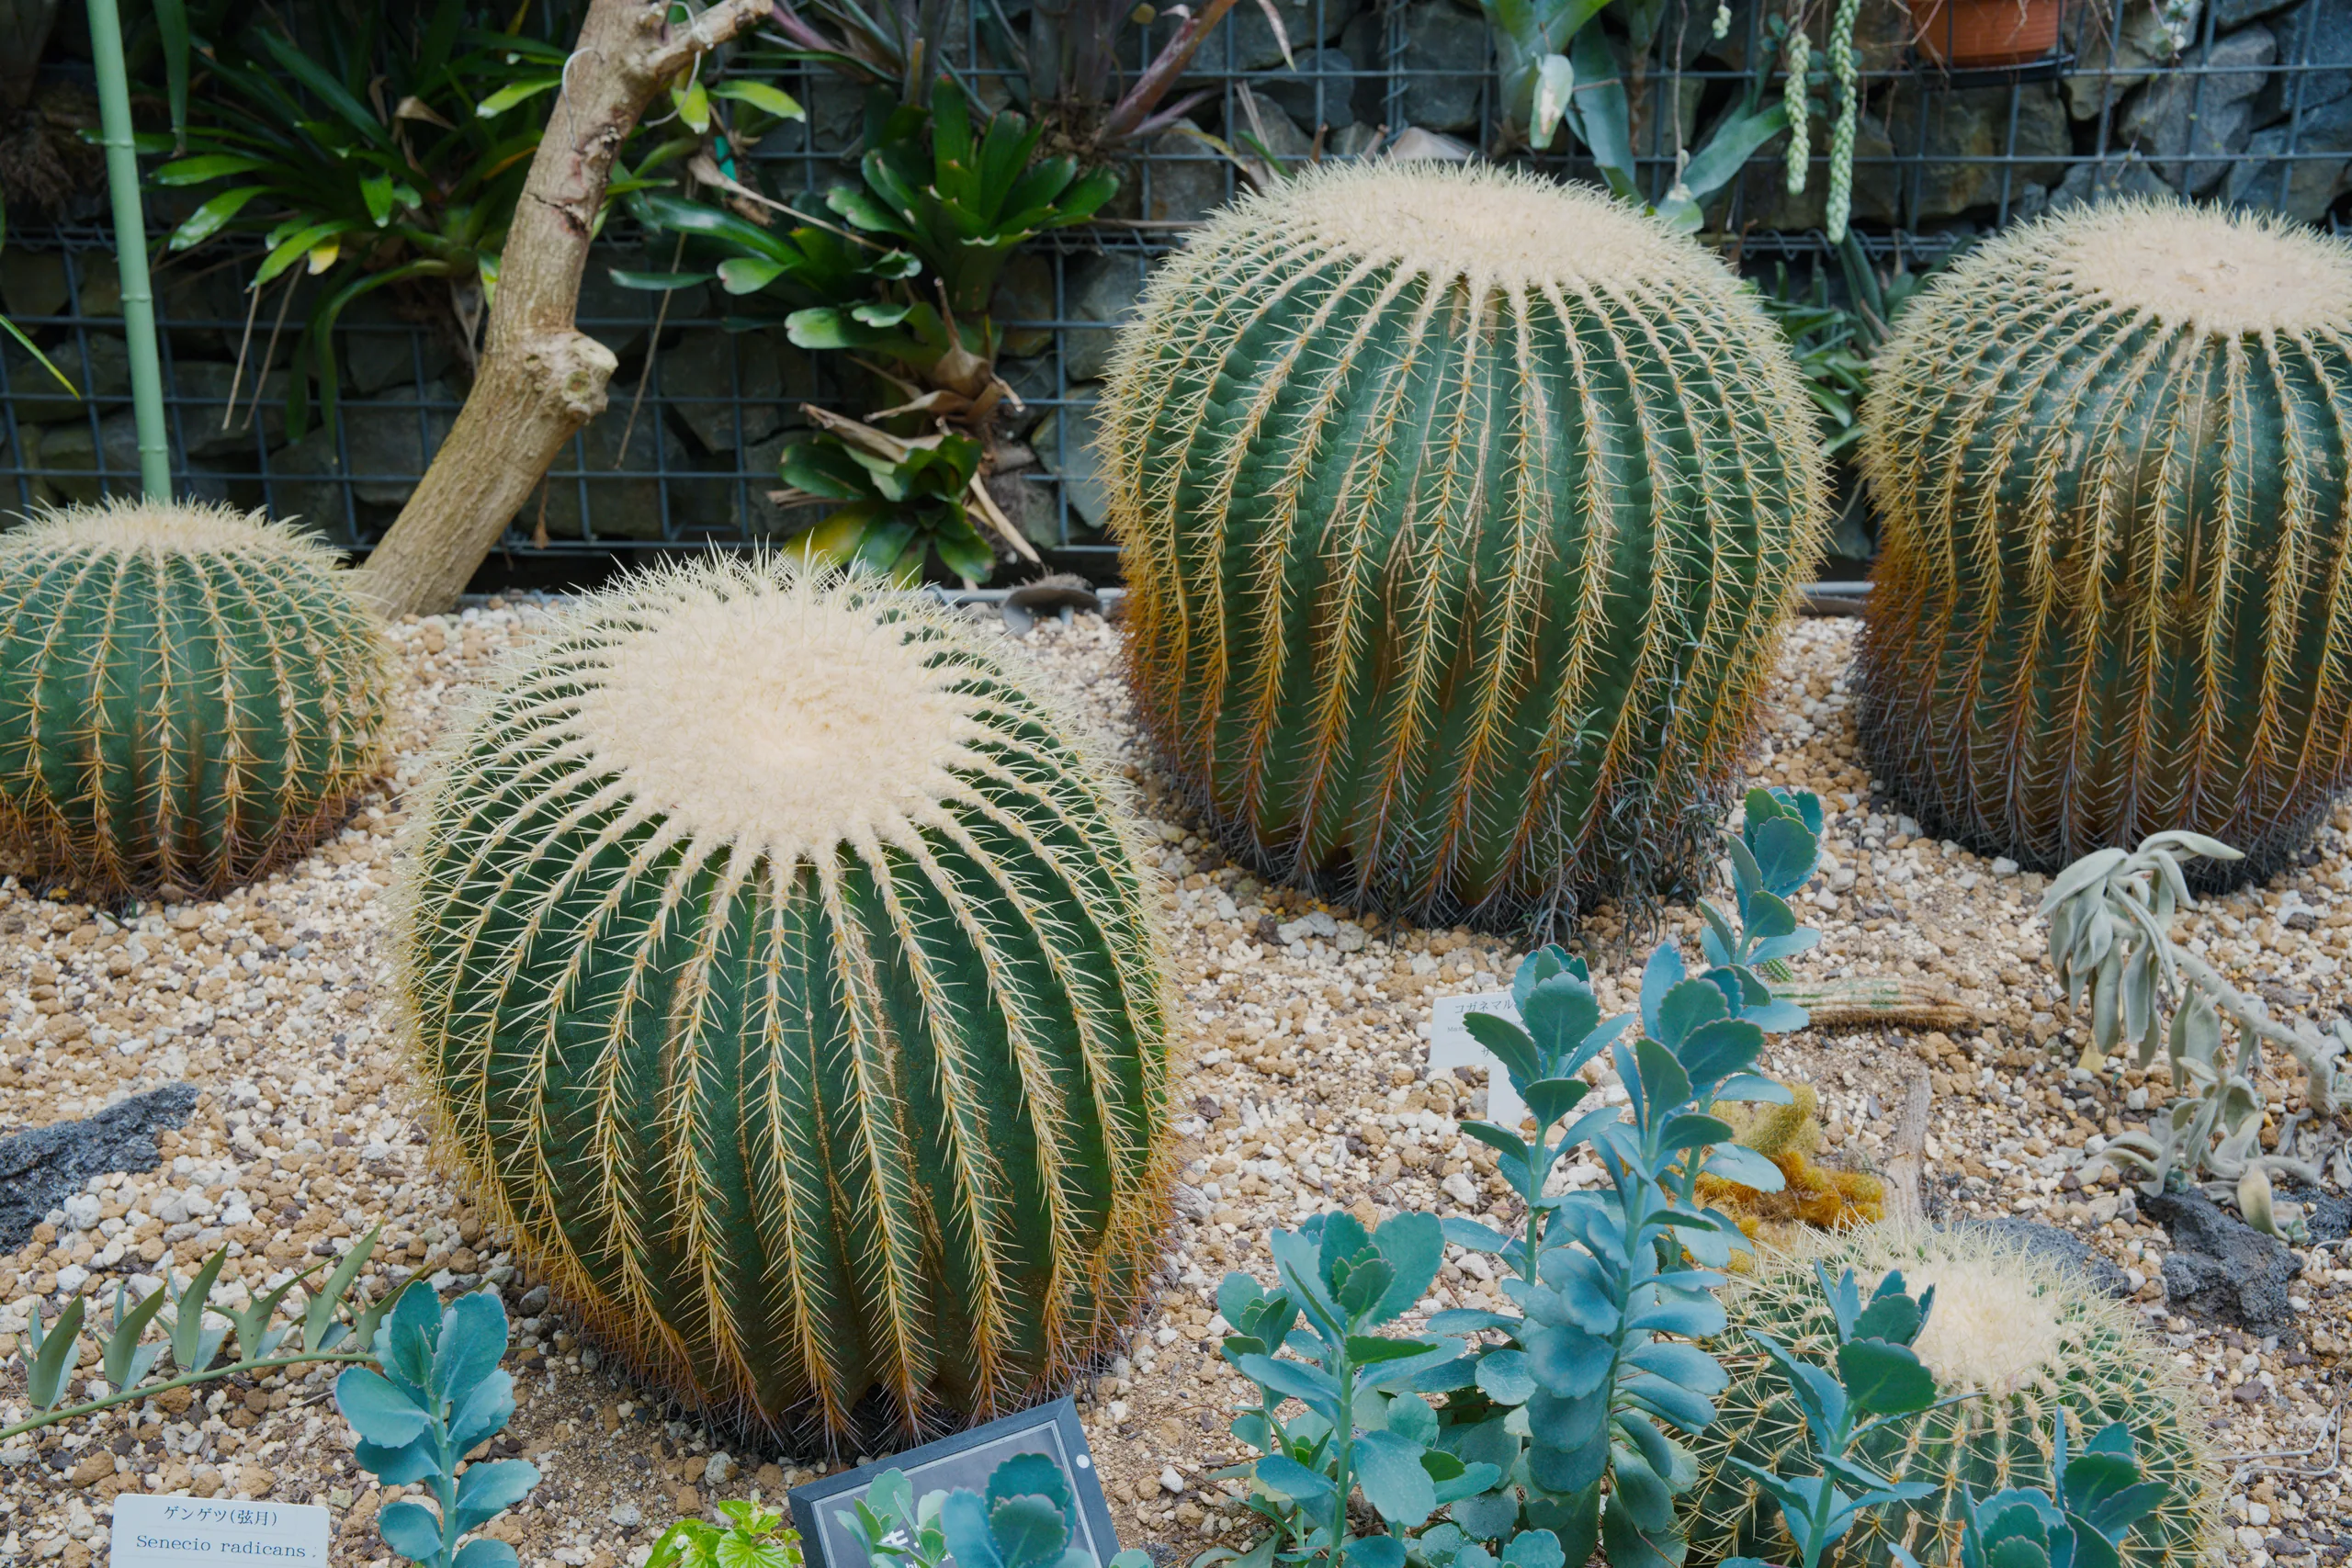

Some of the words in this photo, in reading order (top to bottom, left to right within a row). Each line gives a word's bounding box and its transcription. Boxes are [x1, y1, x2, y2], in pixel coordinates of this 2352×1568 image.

[164, 1505, 278, 1527] ゲンゲツ(弦月)
[136, 1534, 211, 1551] Senecio
[220, 1540, 306, 1558] radicans
